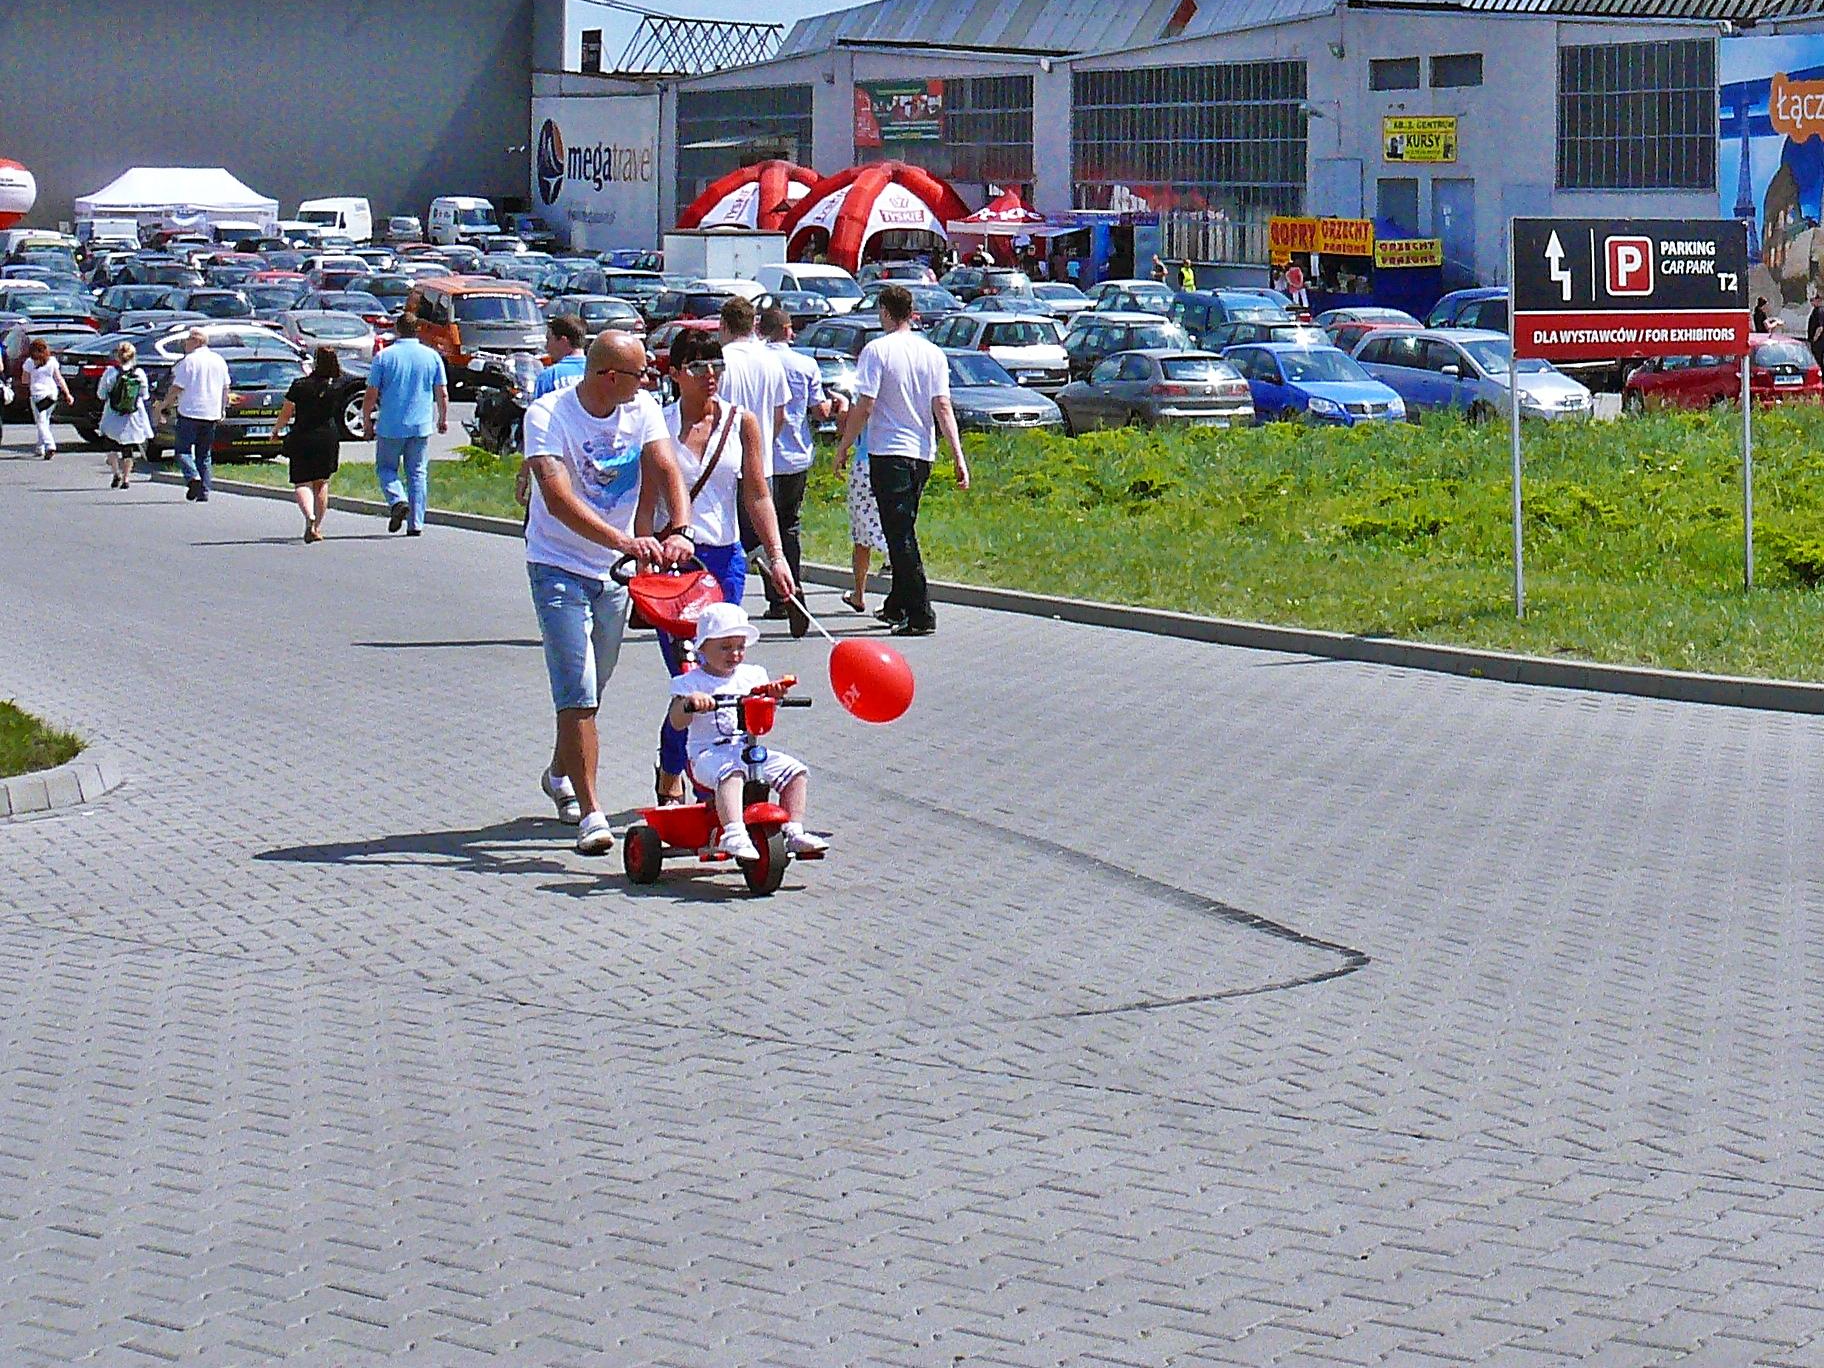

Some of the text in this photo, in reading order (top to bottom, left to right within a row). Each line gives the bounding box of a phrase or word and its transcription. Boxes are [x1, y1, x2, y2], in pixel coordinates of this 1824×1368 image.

[1406, 134, 1441, 148] KURSY
[567, 136, 655, 192] megatravel
[881, 209, 924, 223] TYSKIE
[1270, 222, 1317, 250] GOFRY
[1321, 220, 1370, 242] ORZECHY
[1660, 240, 1716, 256] PARKING
[1617, 246, 1643, 287] P
[1661, 259, 1715, 275] CAR PARK
[1717, 273, 1738, 292] T2
[1533, 330, 1558, 344] DLA
[1558, 327, 1637, 343] WYSTAWCÓW
[1645, 329, 1669, 342] FOR
[1670, 328, 1735, 342] EXHIBITORS
